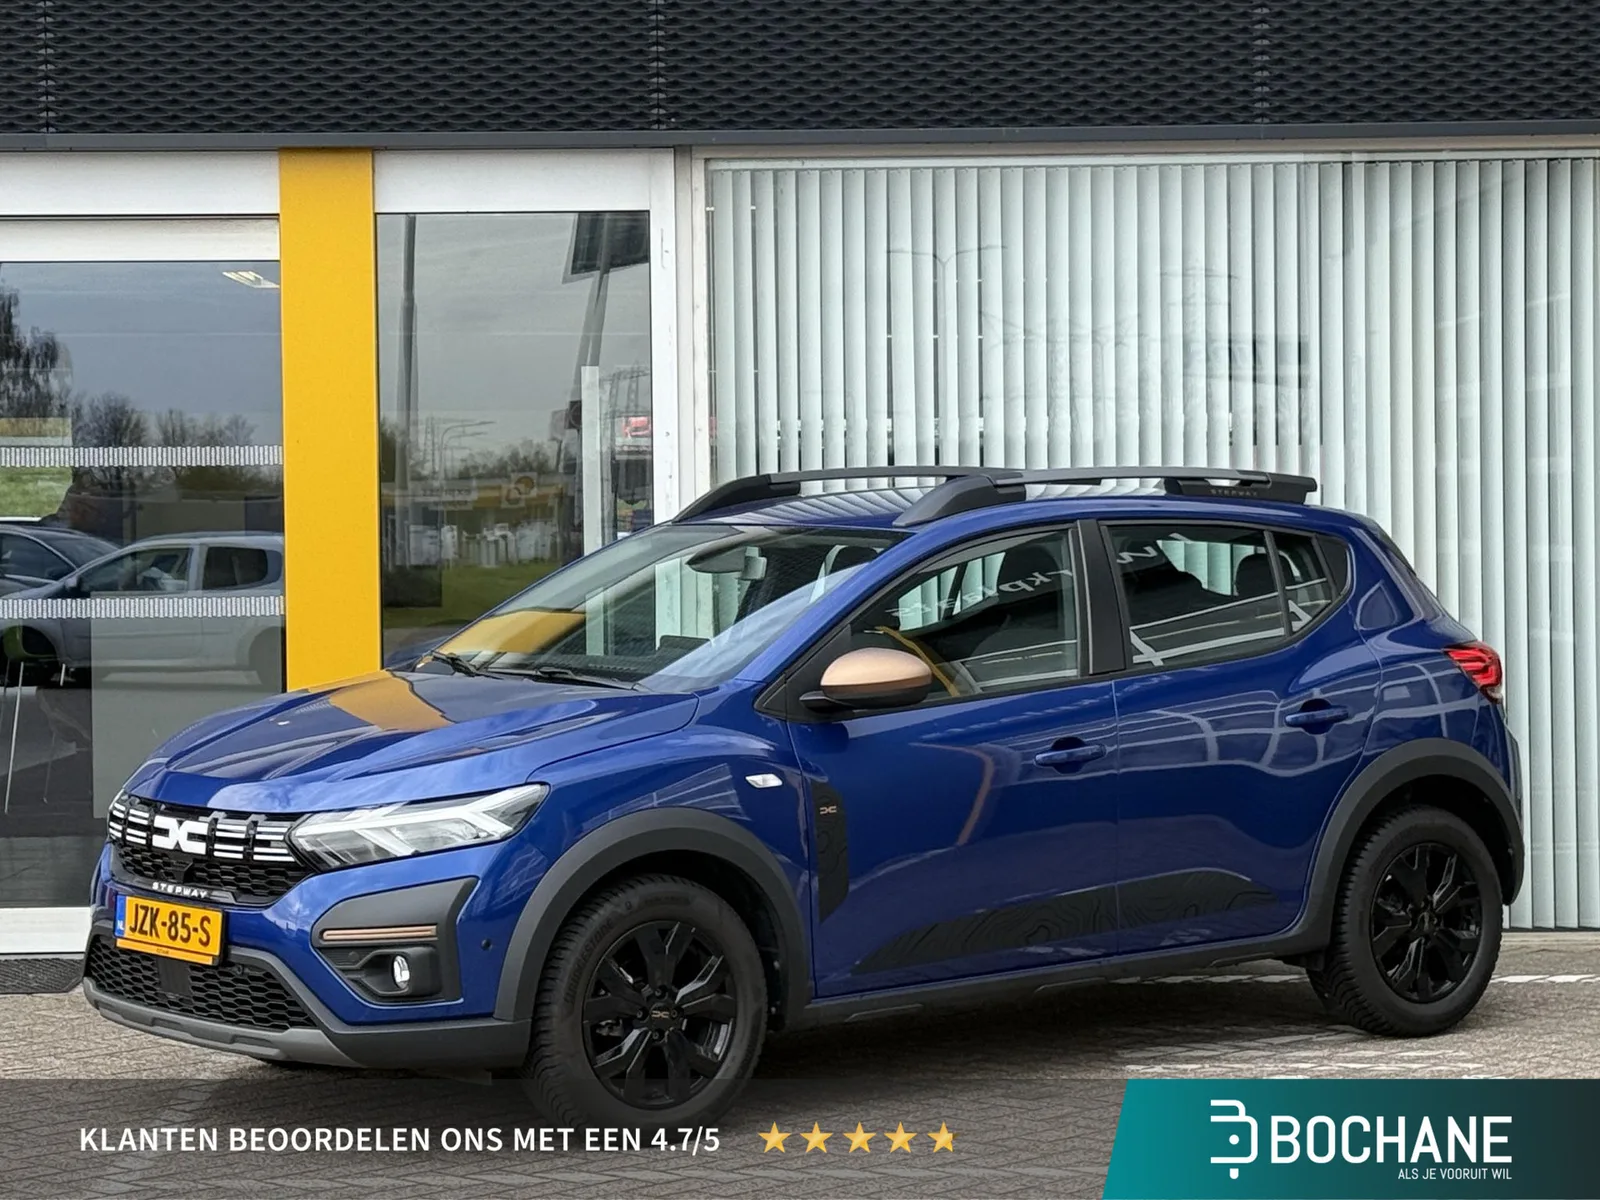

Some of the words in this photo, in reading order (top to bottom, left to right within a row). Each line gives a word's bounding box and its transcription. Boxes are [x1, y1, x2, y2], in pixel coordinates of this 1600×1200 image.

[152, 881, 208, 899] STEPWAY
[116, 919, 125, 931] NL
[129, 902, 212, 948] JZK-85-S
